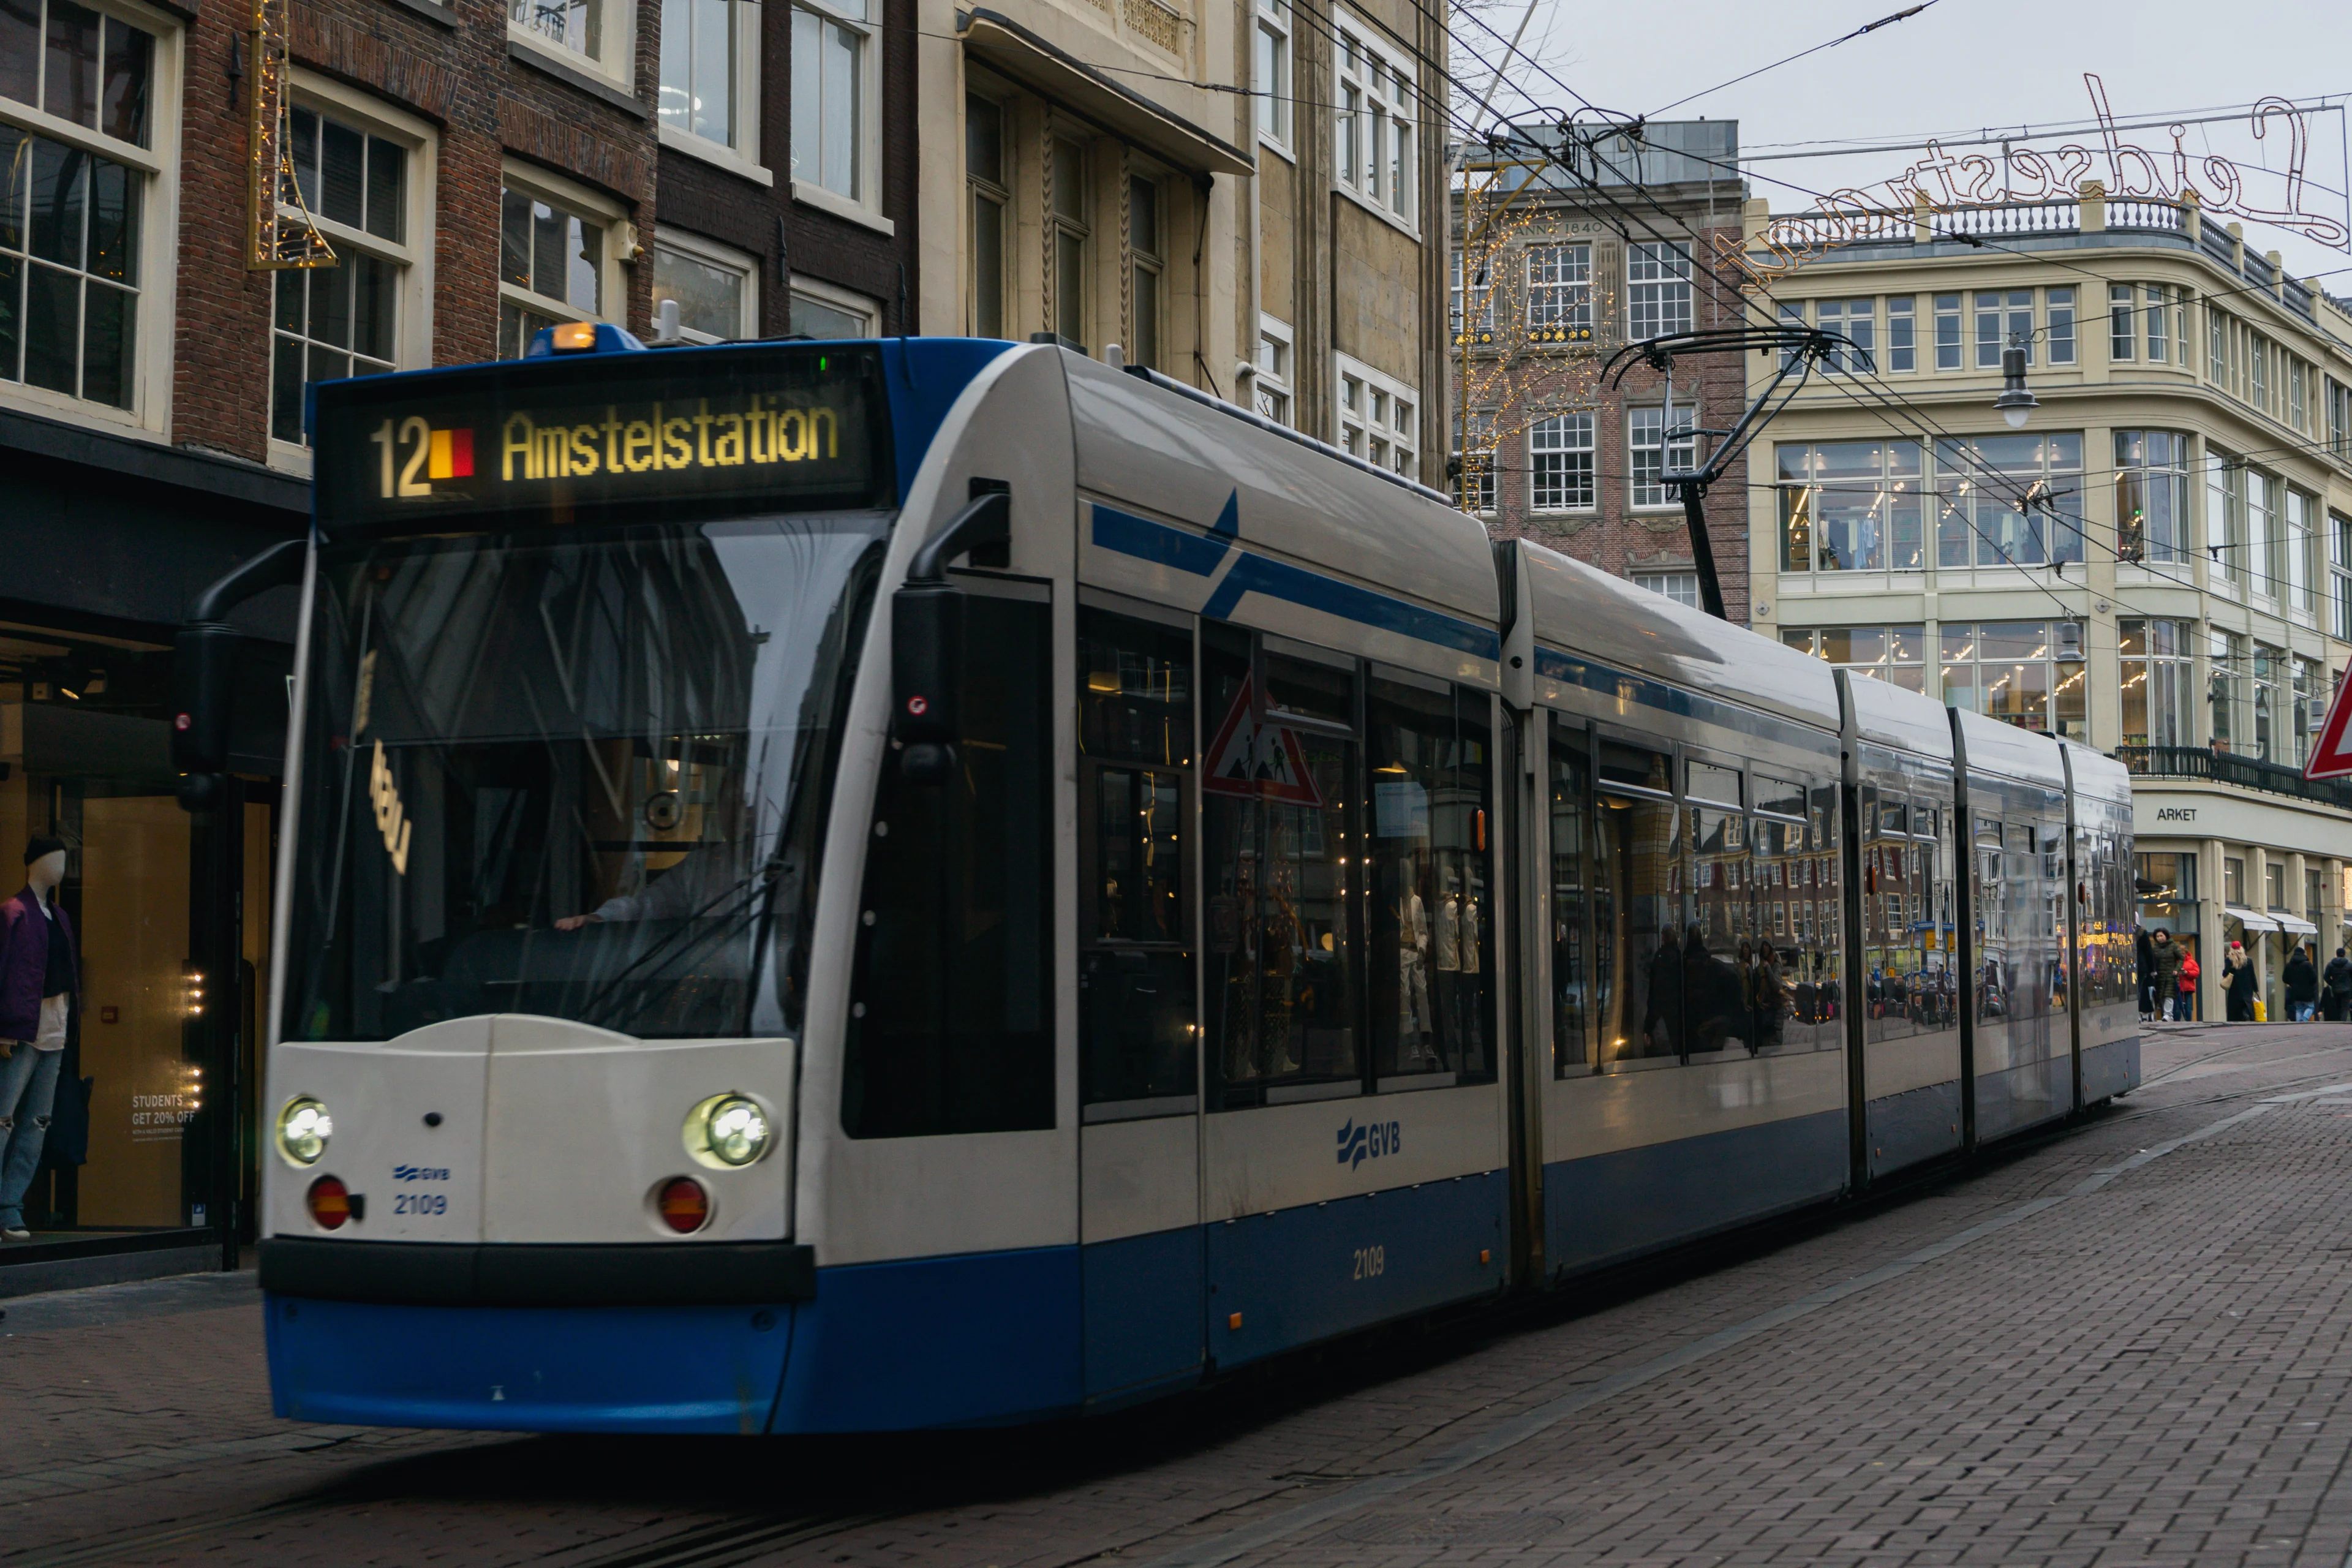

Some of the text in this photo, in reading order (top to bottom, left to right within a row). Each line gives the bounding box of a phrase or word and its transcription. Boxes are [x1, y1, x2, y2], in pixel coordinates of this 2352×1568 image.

[1565, 222, 1602, 234] 1840
[370, 394, 837, 497] 12 Amstelstation
[2157, 808, 2197, 821] ARKET
[133, 1094, 183, 1108] STUDENTS
[132, 1110, 195, 1125] GET 20% OFF
[1369, 1121, 1400, 1158] GVB
[421, 1167, 450, 1180] GVB
[394, 1194, 447, 1215] 2109
[1354, 1245, 1384, 1280] 2109
